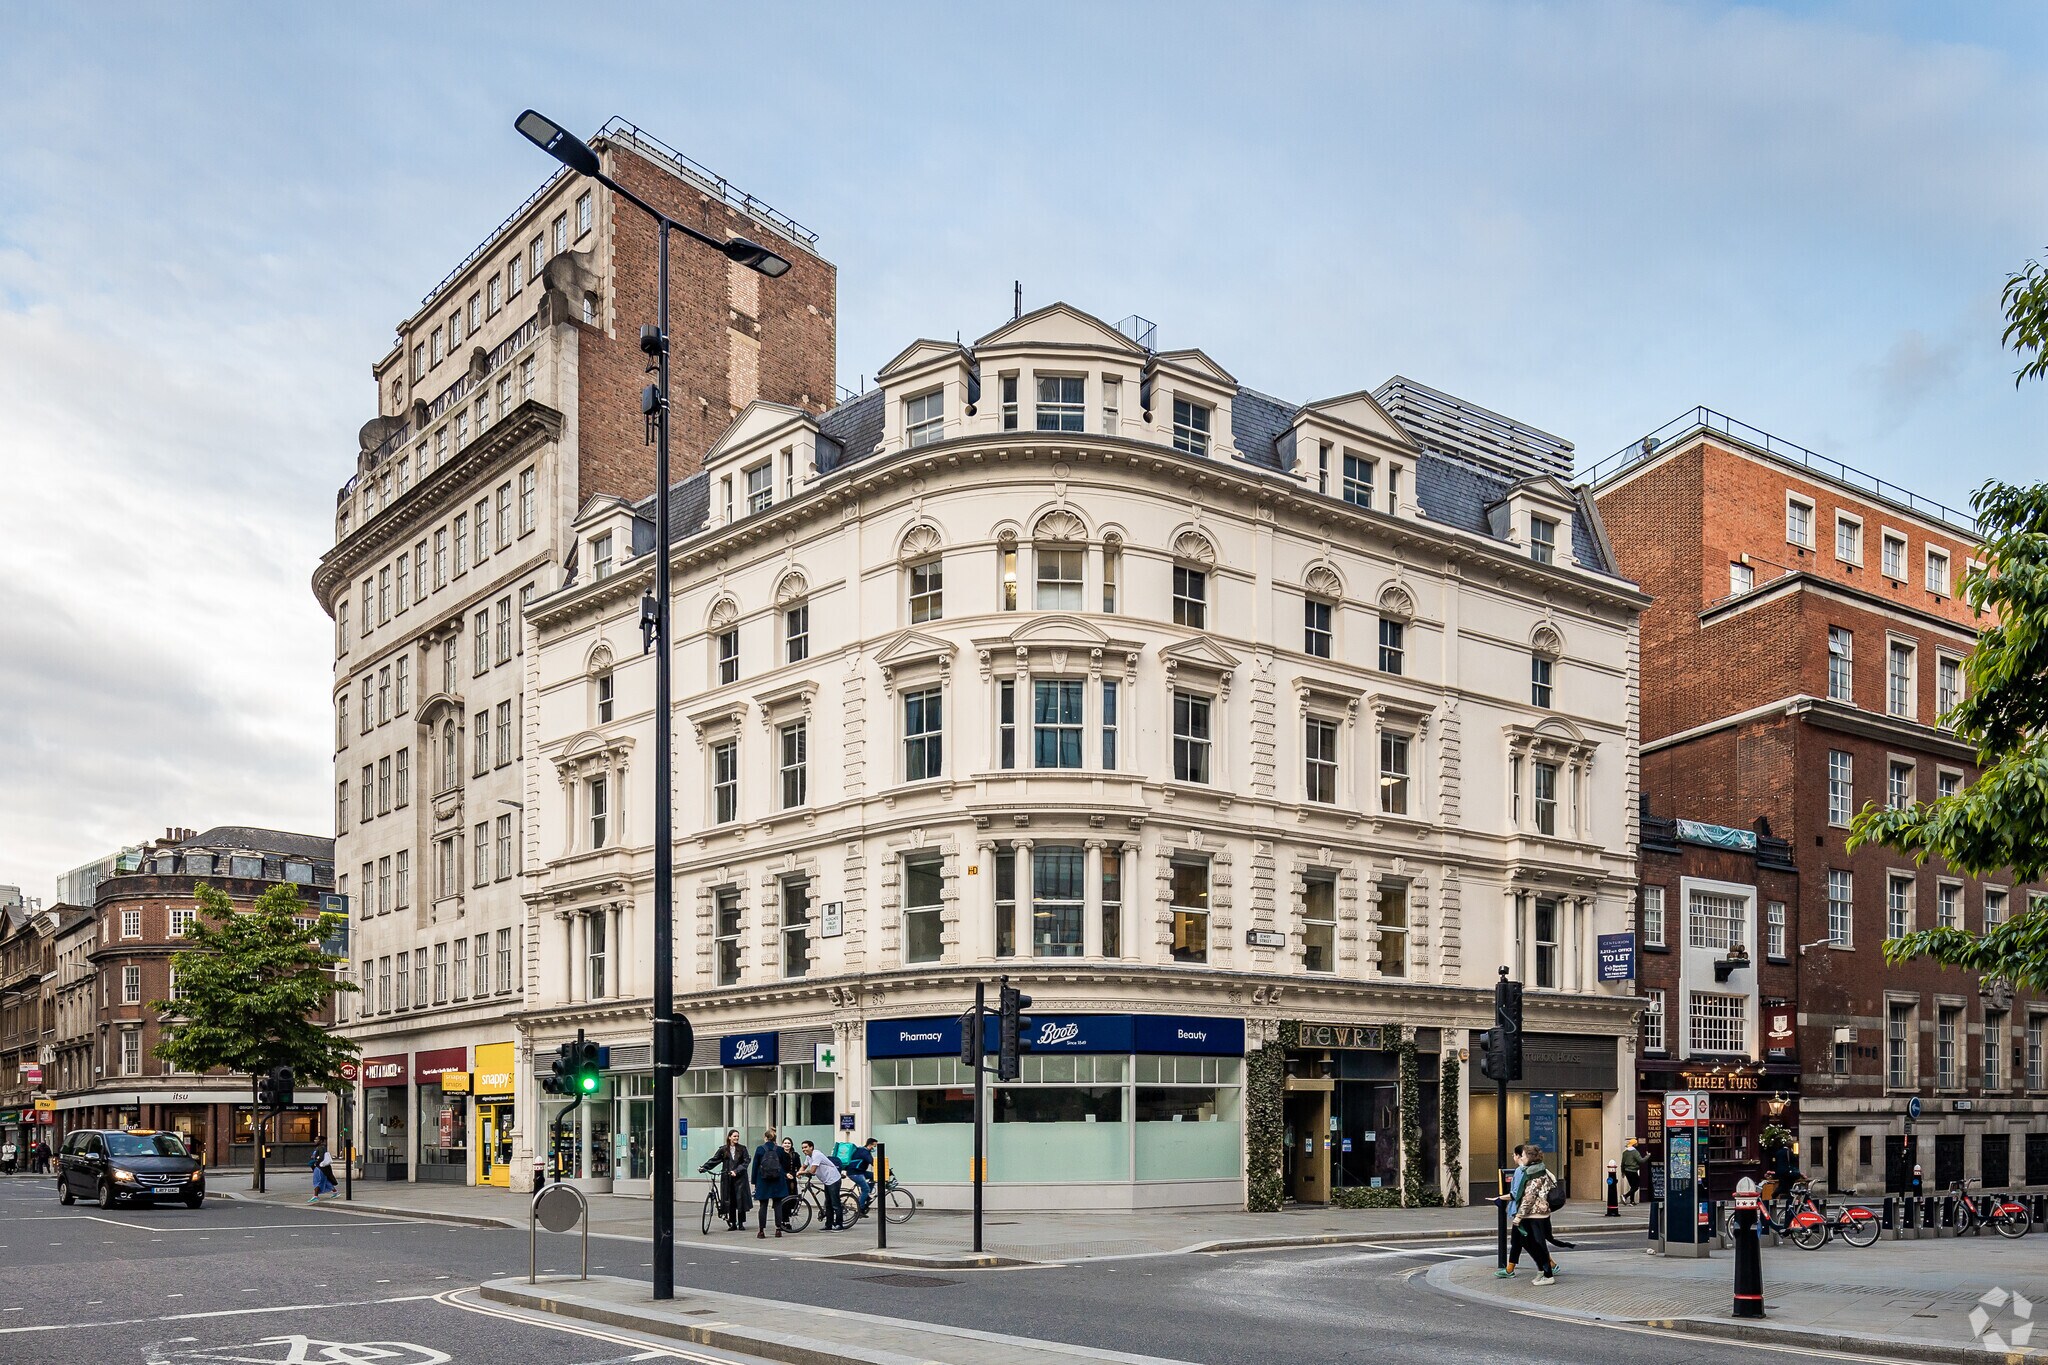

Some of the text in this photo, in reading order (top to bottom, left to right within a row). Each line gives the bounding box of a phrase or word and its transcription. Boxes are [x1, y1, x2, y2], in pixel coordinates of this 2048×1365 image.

[1615, 953, 1630, 961] LET
[899, 1031, 943, 1042] Pharmacy
[1036, 1022, 1079, 1045] Boots
[1177, 1029, 1207, 1042] Beauty
[1302, 1026, 1379, 1048] JEWRY
[733, 1039, 759, 1060] Boots
[481, 1072, 510, 1088] snappy
[1686, 1076, 1758, 1089] THREE TUNS
